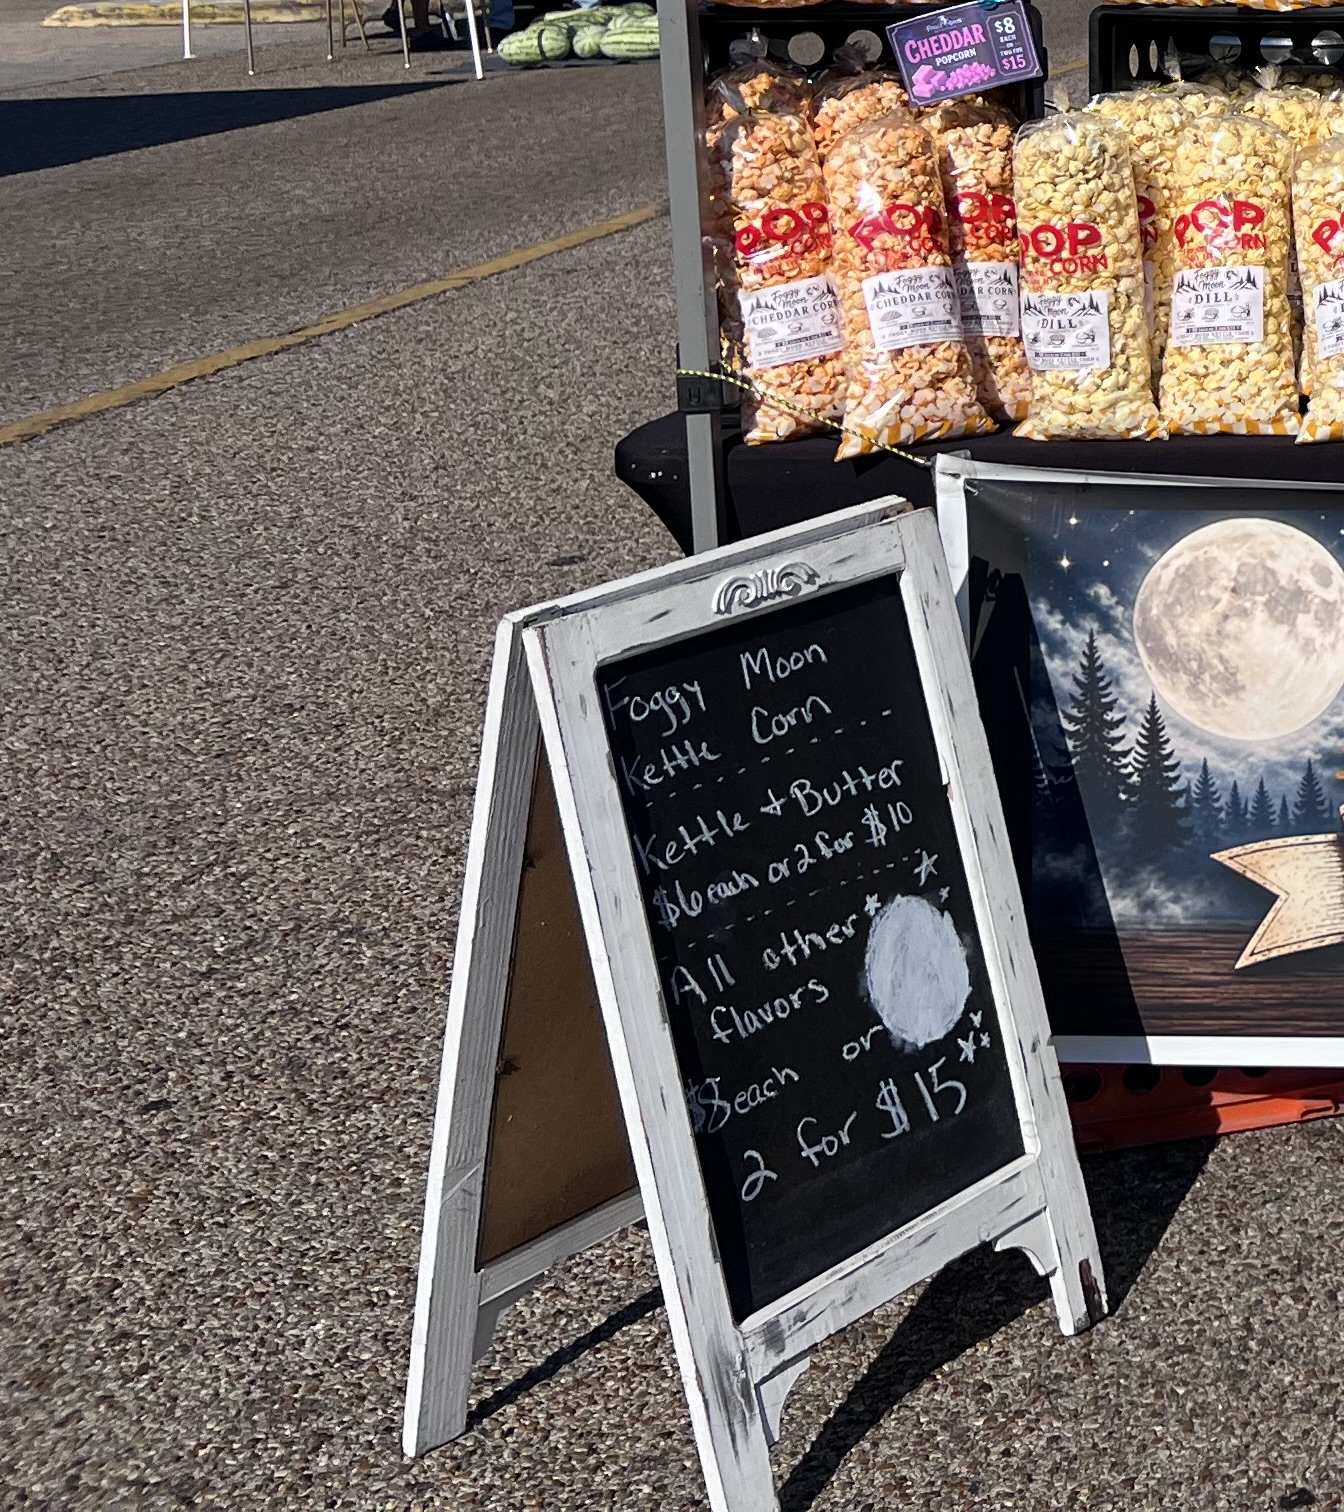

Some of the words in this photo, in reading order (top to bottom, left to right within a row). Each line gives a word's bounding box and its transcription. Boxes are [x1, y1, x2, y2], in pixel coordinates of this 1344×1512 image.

[993, 16, 1016, 34] $8
[904, 23, 987, 65] CHEDDAR
[934, 47, 978, 67] POPCORN
[1001, 53, 1027, 71] $15
[1173, 199, 1267, 248] POP
[1049, 253, 1110, 275] CORN
[1192, 266, 1221, 284] Foggy
[1193, 292, 1235, 305] DILL
[1199, 277, 1227, 291] Moon
[873, 291, 934, 311] CHEDDAR
[751, 306, 810, 327] CHEDDAR
[1039, 317, 1080, 330] DILL
[604, 675, 707, 738] Foggy
[739, 643, 828, 691] Moon
[620, 739, 722, 796] Kettle
[750, 694, 833, 745] Corn
[632, 809, 751, 876] Kettle
[788, 758, 904, 818] Butter
[767, 856, 790, 885] or
[793, 842, 818, 875] 2
[814, 830, 855, 860] for
[861, 800, 914, 848] $10
[670, 953, 737, 1006] All
[761, 912, 860, 972] other
[709, 978, 830, 1045] flavors
[841, 1024, 885, 1062] or
[740, 1149, 779, 1203] 2
[796, 1110, 858, 1169] for
[874, 1055, 968, 1140] $15
